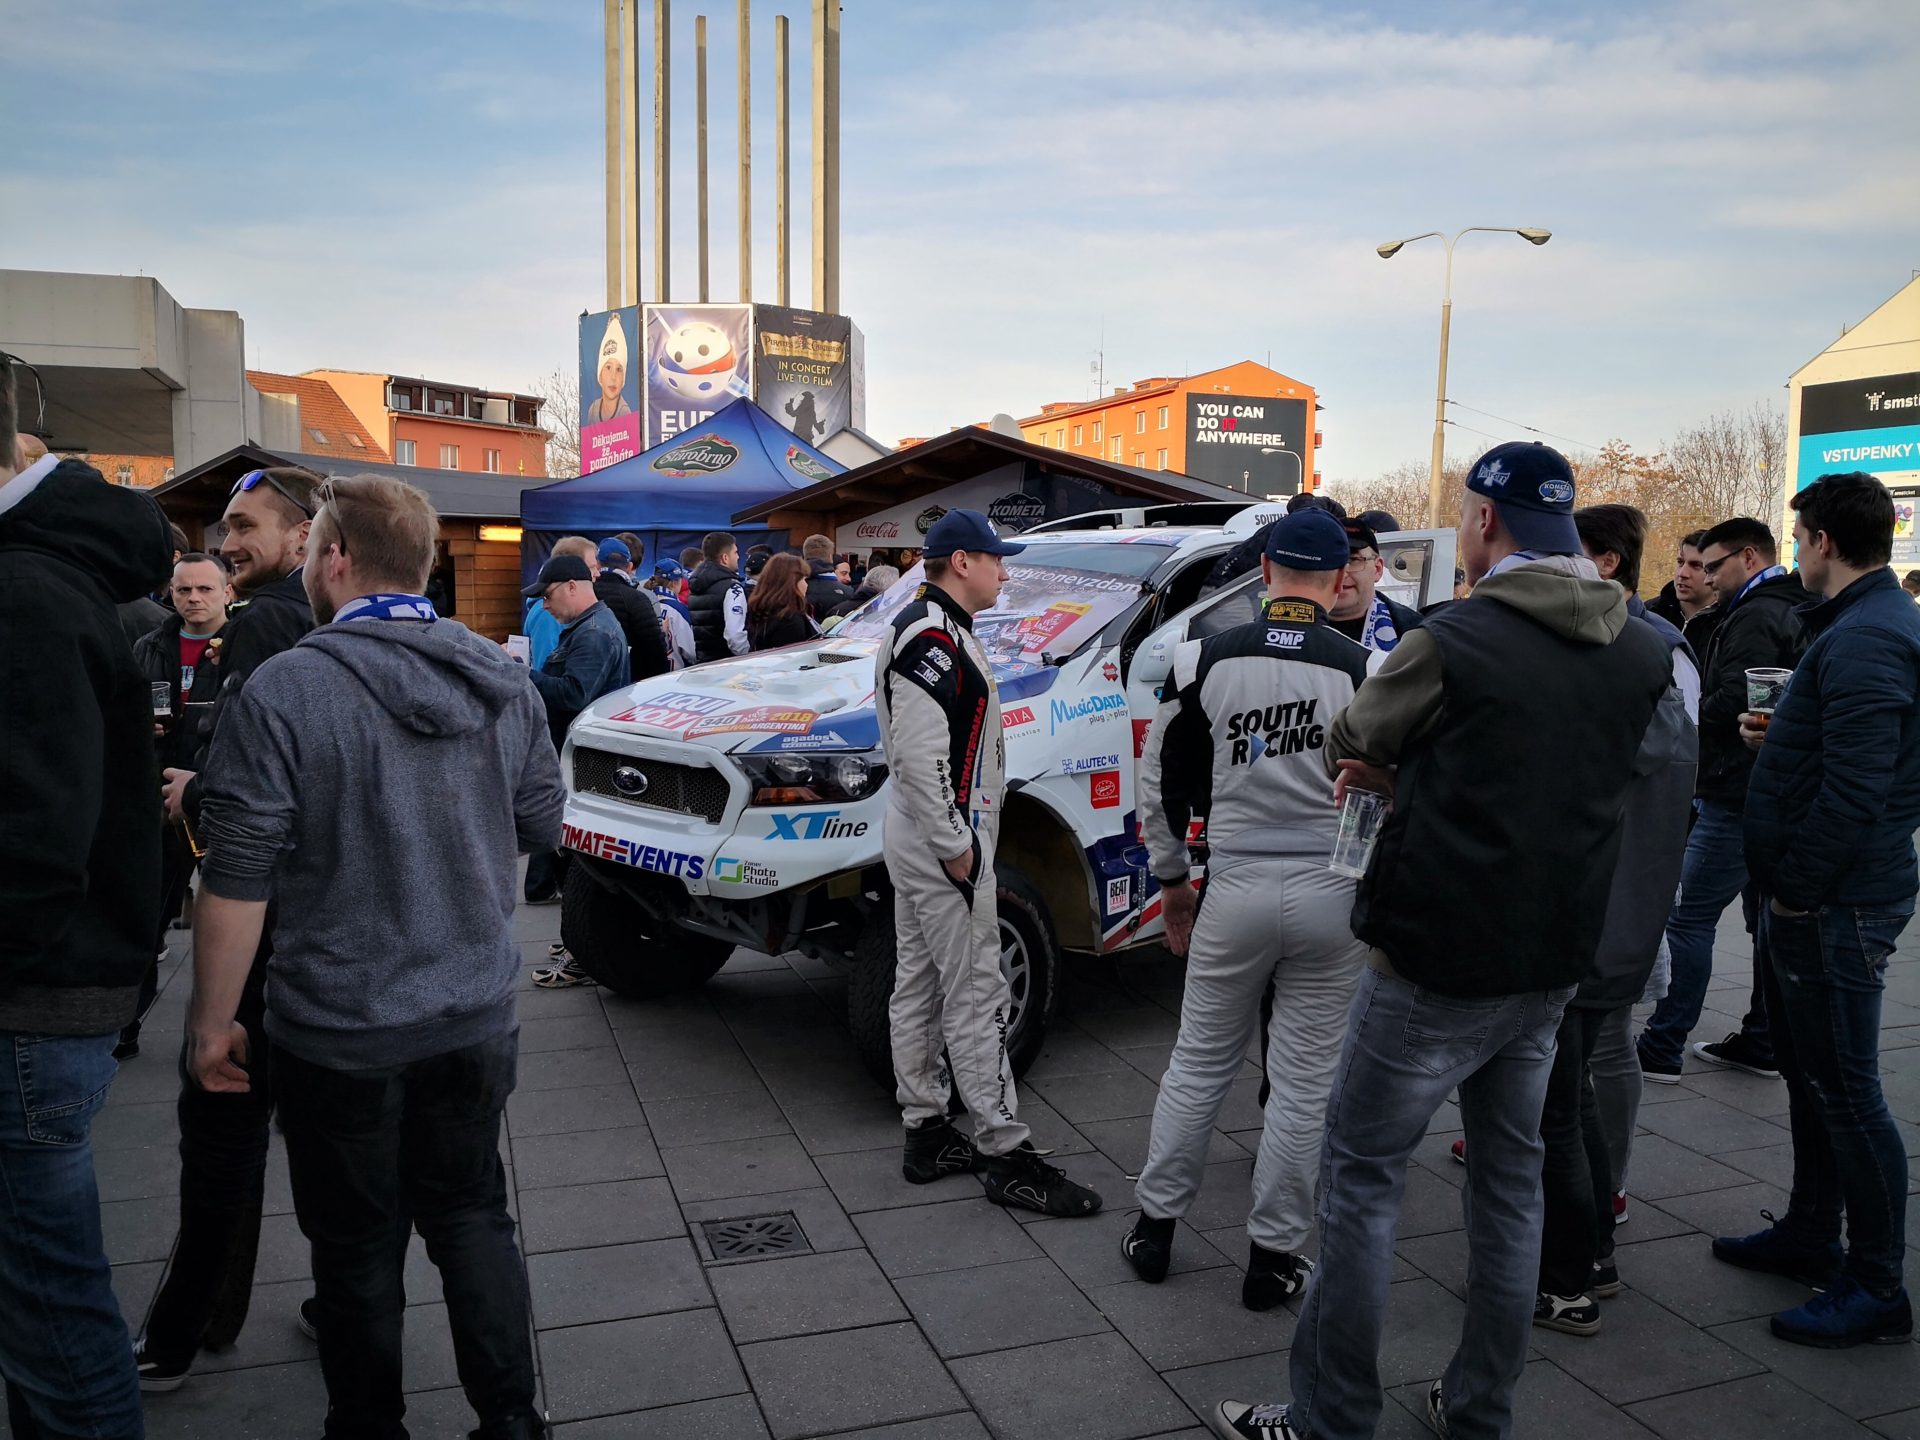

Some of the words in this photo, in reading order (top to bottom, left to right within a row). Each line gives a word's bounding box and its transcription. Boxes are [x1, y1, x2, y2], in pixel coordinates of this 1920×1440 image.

[779, 361, 788, 370] IN
[791, 362, 831, 375] CONCERT
[777, 372, 794, 383] LIVE
[798, 375, 810, 384] TO
[813, 376, 833, 386] FILM
[1197, 403, 1229, 416] YOU
[1233, 405, 1264, 419] CAN
[1197, 417, 1219, 430] DO
[1222, 418, 1237, 431] IT
[1196, 430, 1286, 447] ANYWHERE.
[660, 445, 732, 469] Starobrno
[1822, 443, 1914, 463] VSTUPENKY
[1544, 483, 1570, 492] KOMETA
[990, 504, 1046, 516] KOMETA
[1266, 630, 1306, 647] OMP
[930, 646, 953, 667] SOUTH
[646, 693, 727, 714] LIQUI
[614, 705, 698, 727] MOLY
[768, 712, 813, 722] 2018
[1002, 710, 1031, 726] DIA
[1089, 713, 1106, 727] plug
[1114, 708, 1130, 722] play
[1226, 698, 1318, 741] SOUTH
[750, 722, 806, 731] ARGENTINA
[783, 734, 830, 743] agados
[1076, 756, 1107, 770] ALUTEC
[743, 866, 776, 878] Photo
[743, 877, 779, 887] Studio
[1110, 879, 1128, 898] BEAT
